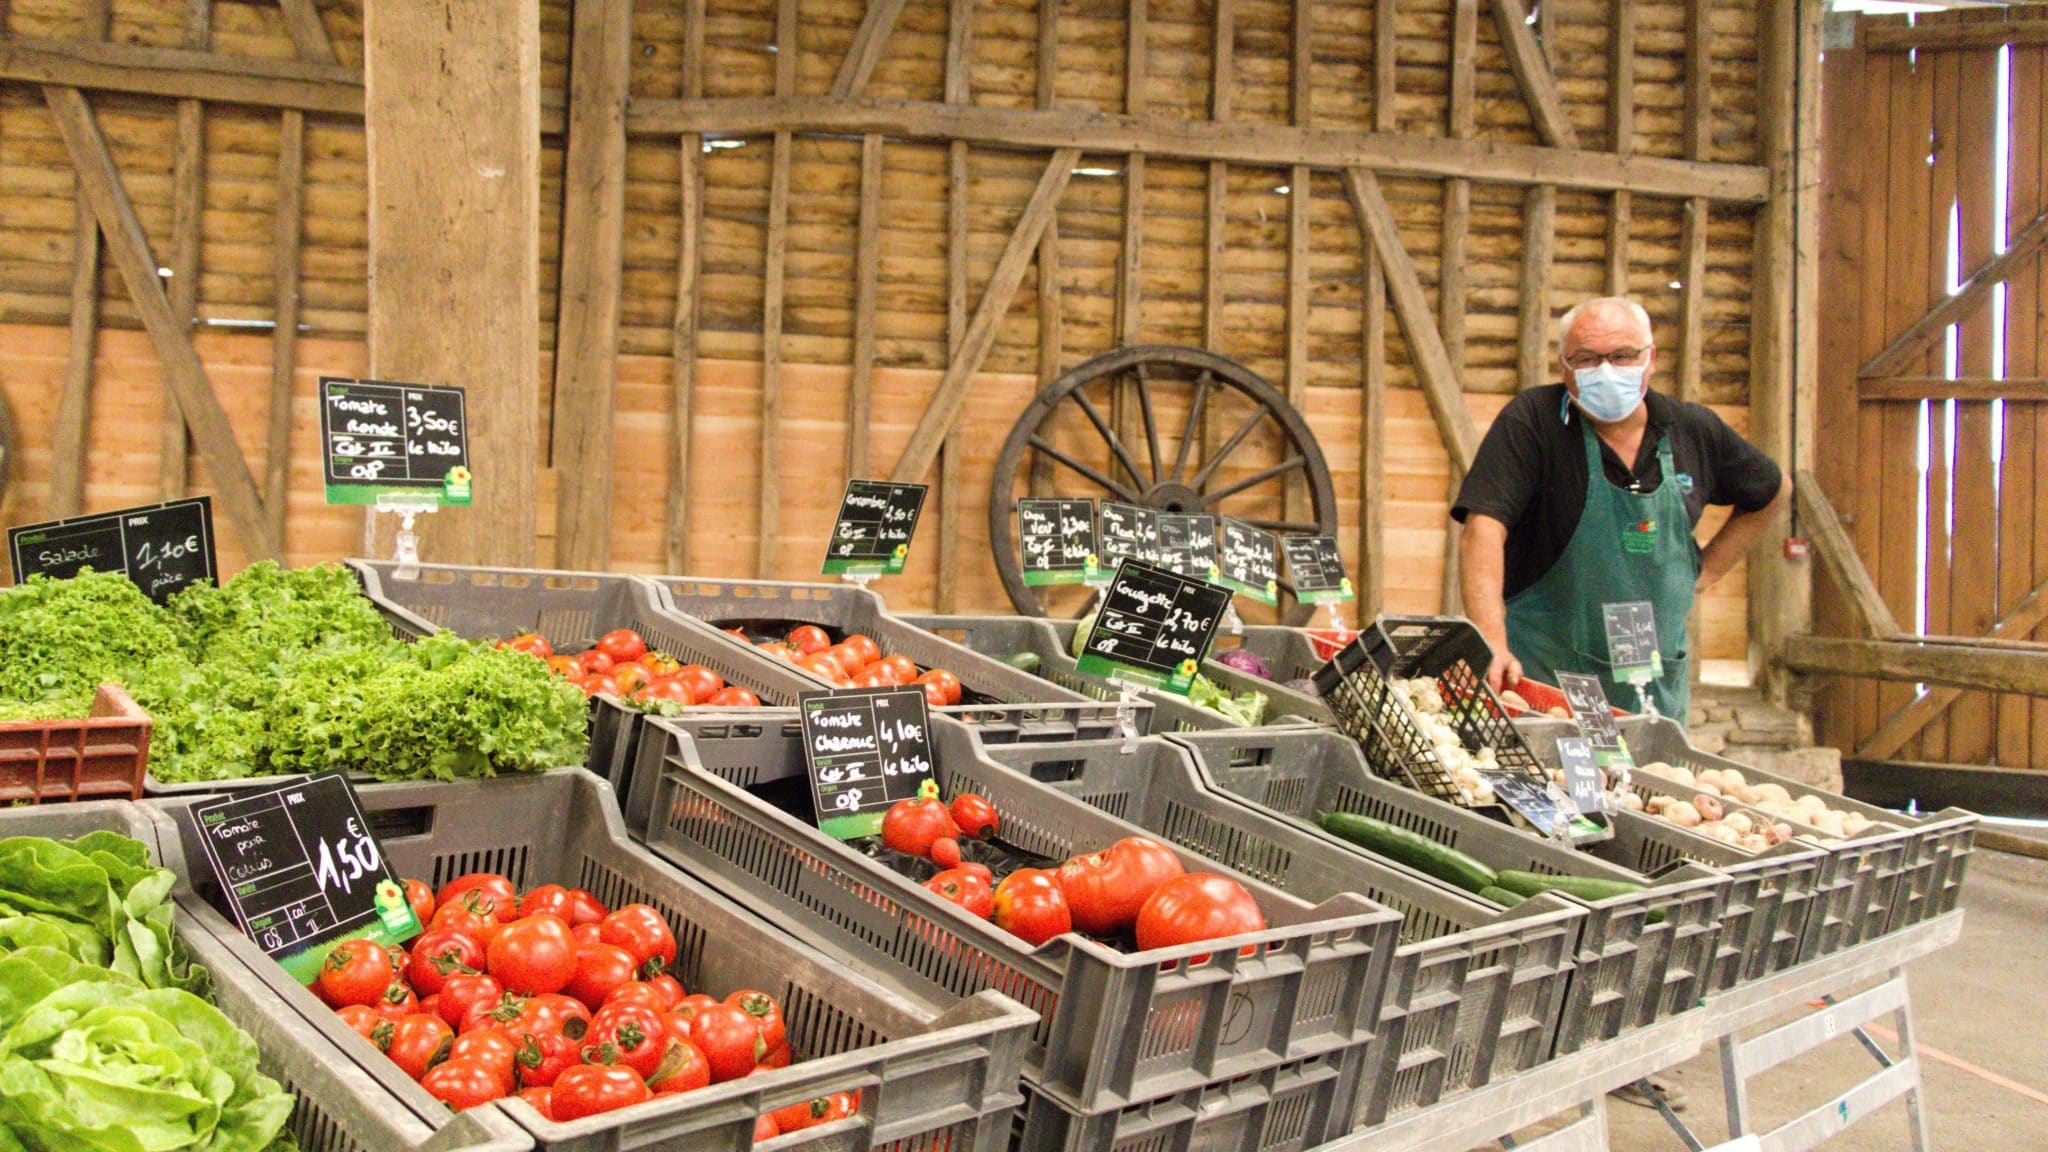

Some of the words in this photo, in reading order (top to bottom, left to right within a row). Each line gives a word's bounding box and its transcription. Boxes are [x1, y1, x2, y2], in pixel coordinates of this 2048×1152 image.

[328, 395, 388, 416] Tomate
[407, 406, 459, 436] 3,50€
[427, 441, 461, 456] kilo
[128, 516, 149, 527] PRIX
[39, 545, 99, 567] Salade
[136, 535, 199, 570] 1,10€
[1116, 580, 1173, 614] Courgette
[809, 710, 863, 728] Tomate
[900, 755, 930, 774] kilo
[286, 792, 305, 805] PRIX
[836, 788, 862, 812] 08
[212, 816, 260, 839] Tomate
[319, 836, 379, 895] 1,50
[264, 927, 283, 949] 08
